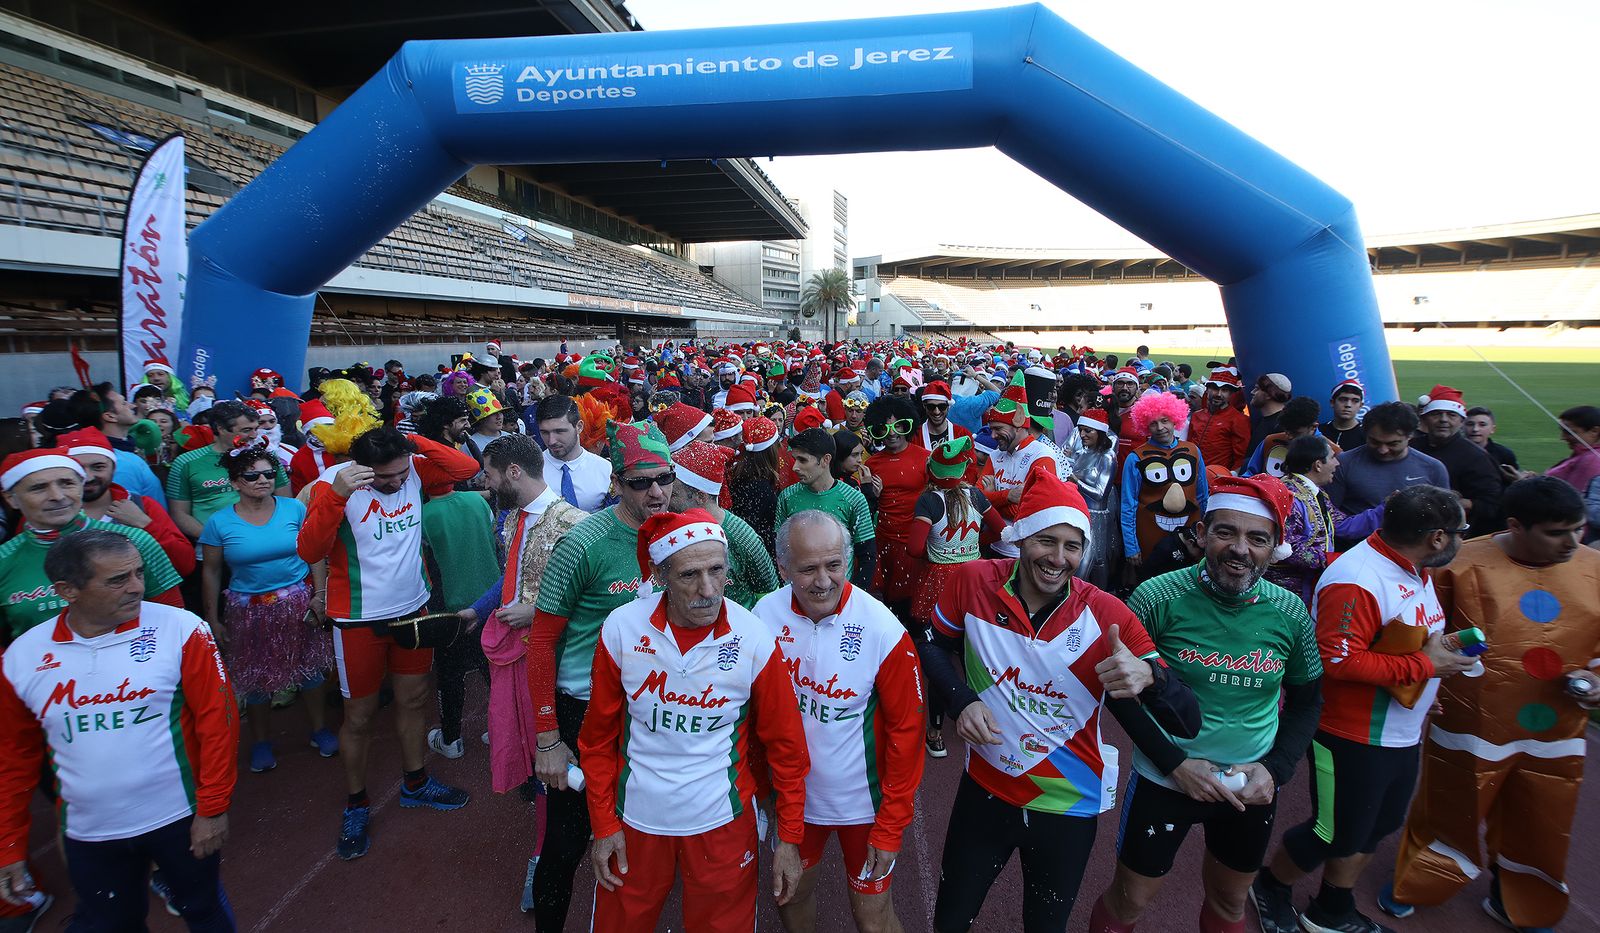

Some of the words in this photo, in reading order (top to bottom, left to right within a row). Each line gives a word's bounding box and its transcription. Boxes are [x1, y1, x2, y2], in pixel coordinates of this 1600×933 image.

[516, 56, 782, 87] Ayuntamiento
[792, 50, 839, 69] de
[849, 46, 955, 71] Jerez
[516, 85, 637, 104] Deportes
[127, 213, 168, 364] aratón
[633, 645, 657, 656] VIATOR
[1178, 648, 1283, 673] maratón
[1208, 672, 1264, 688] JEREZ
[799, 693, 860, 724] EREZ
